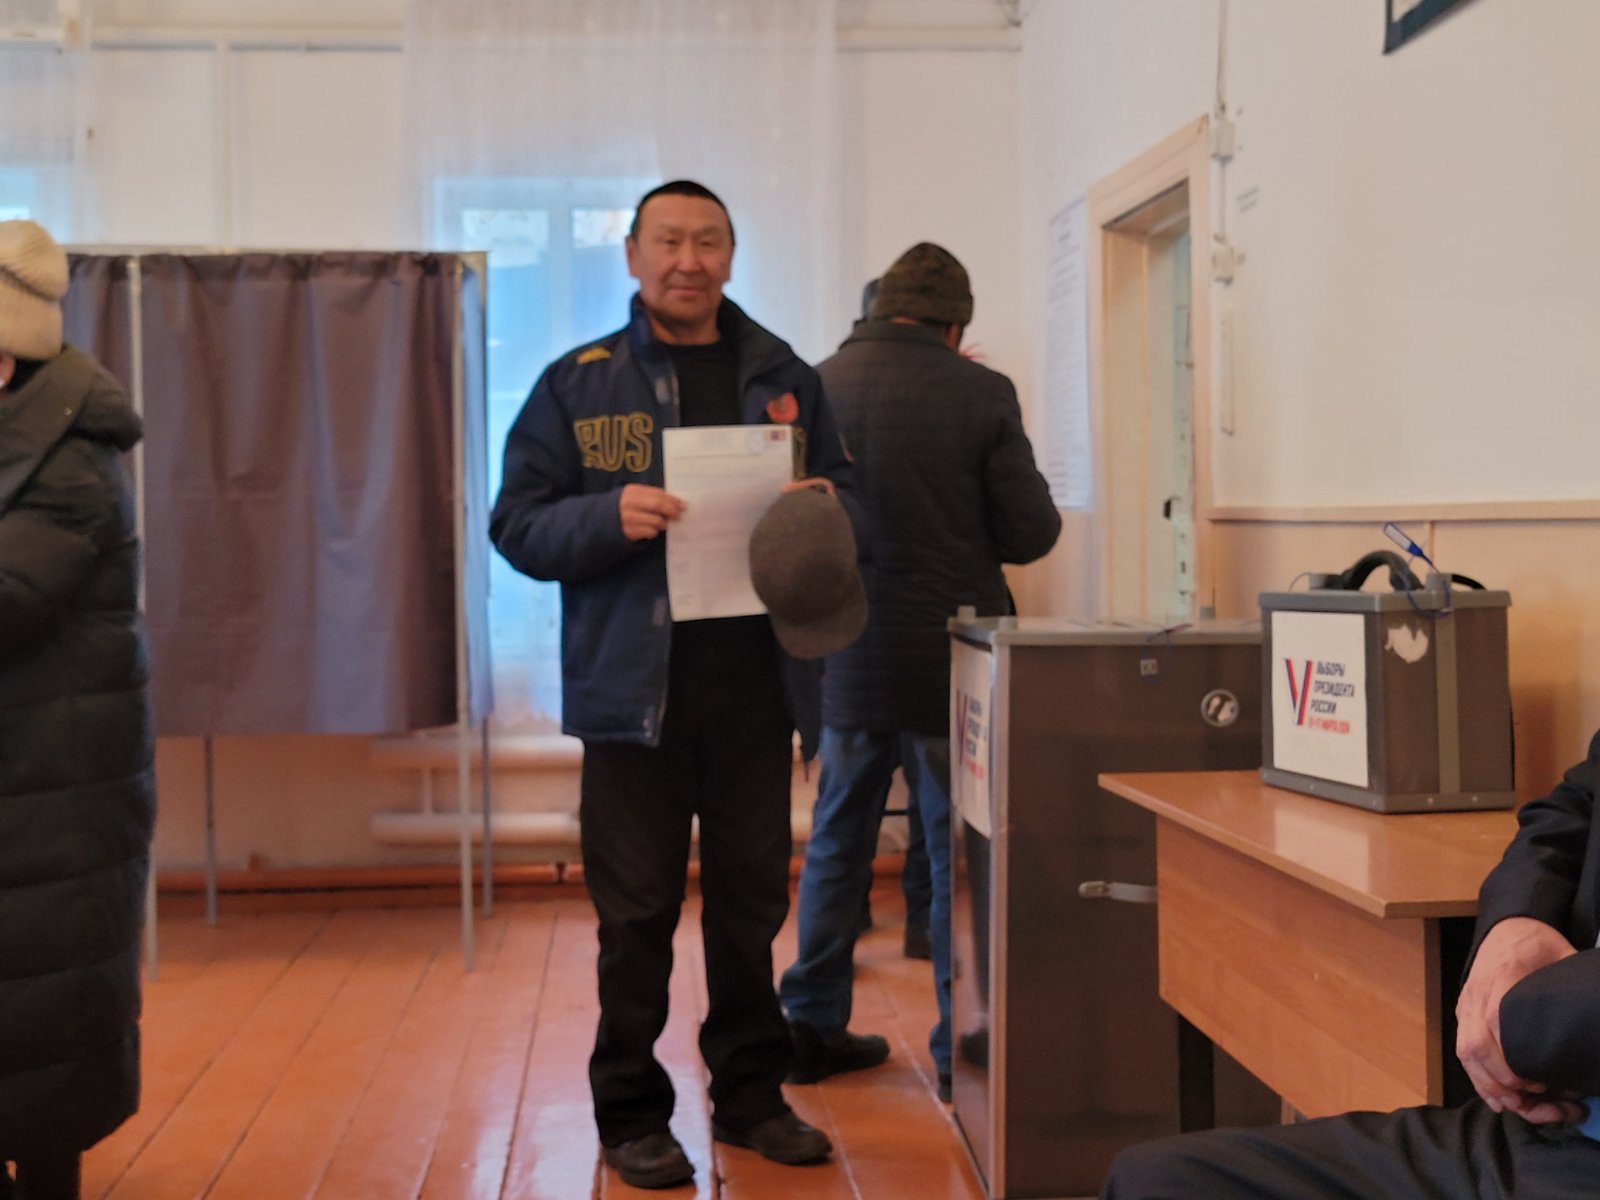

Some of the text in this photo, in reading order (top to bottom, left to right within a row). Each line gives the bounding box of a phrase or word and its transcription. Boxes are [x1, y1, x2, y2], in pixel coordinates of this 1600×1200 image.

[574, 412, 653, 472] RUS
[1316, 661, 1346, 677] ВЫБОРЫ
[1313, 681, 1355, 698] ПРЕЗИДЕНТА
[1311, 699, 1337, 714] РОССИИ
